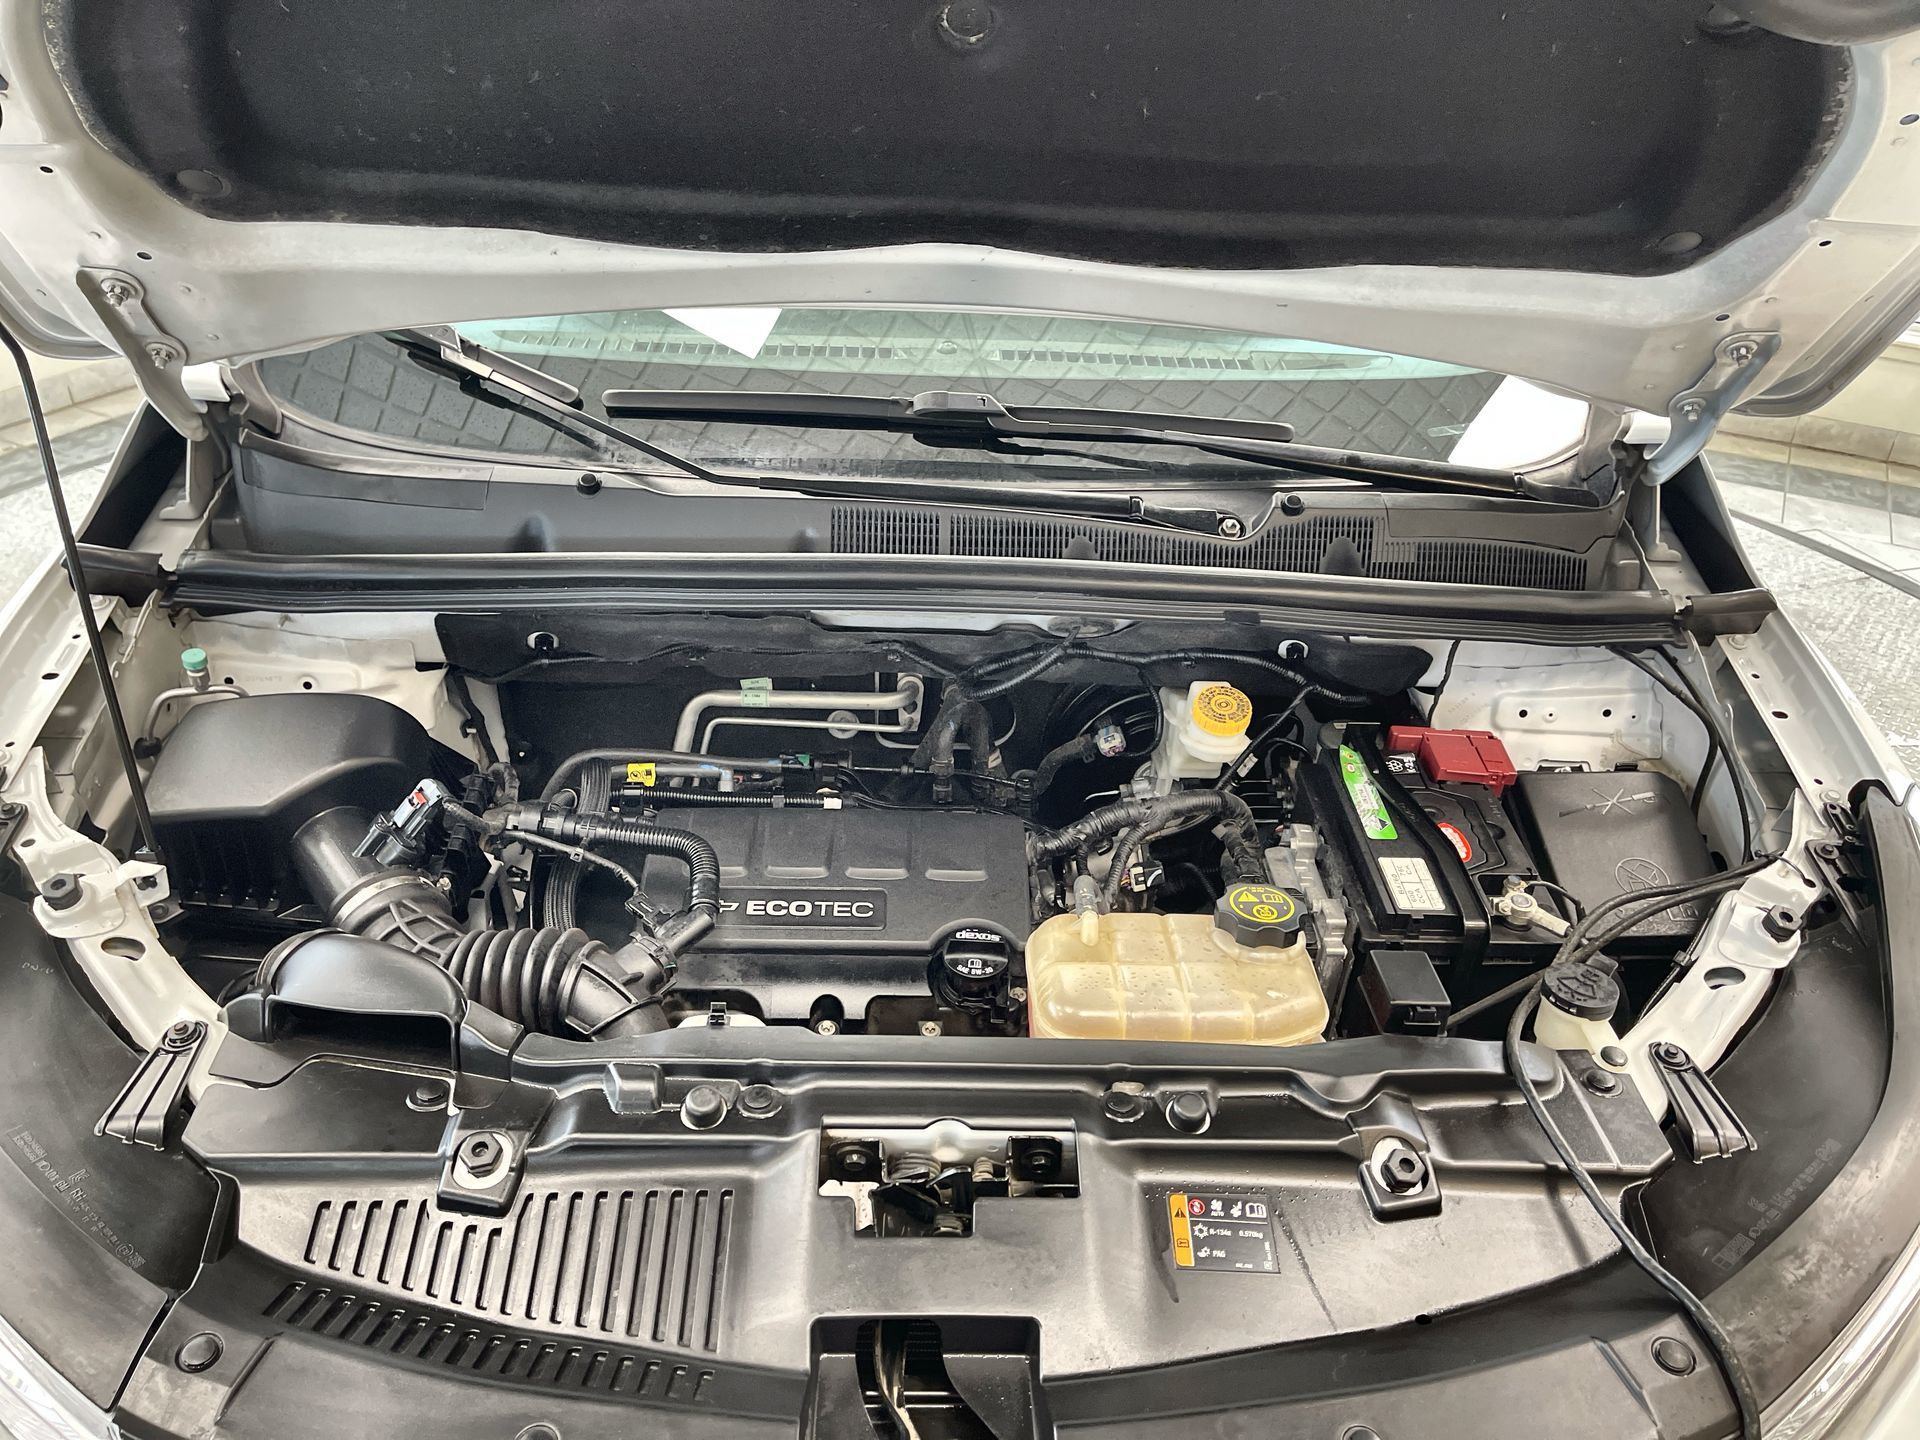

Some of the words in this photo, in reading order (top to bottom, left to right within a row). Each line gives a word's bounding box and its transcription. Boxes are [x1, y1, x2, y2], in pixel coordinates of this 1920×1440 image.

[745, 899, 875, 918] ECOTEC
[955, 929, 1002, 942] dexos
[956, 964, 970, 974] SAE
[970, 966, 994, 975] 5W-30
[1212, 1250, 1226, 1258] PAG
